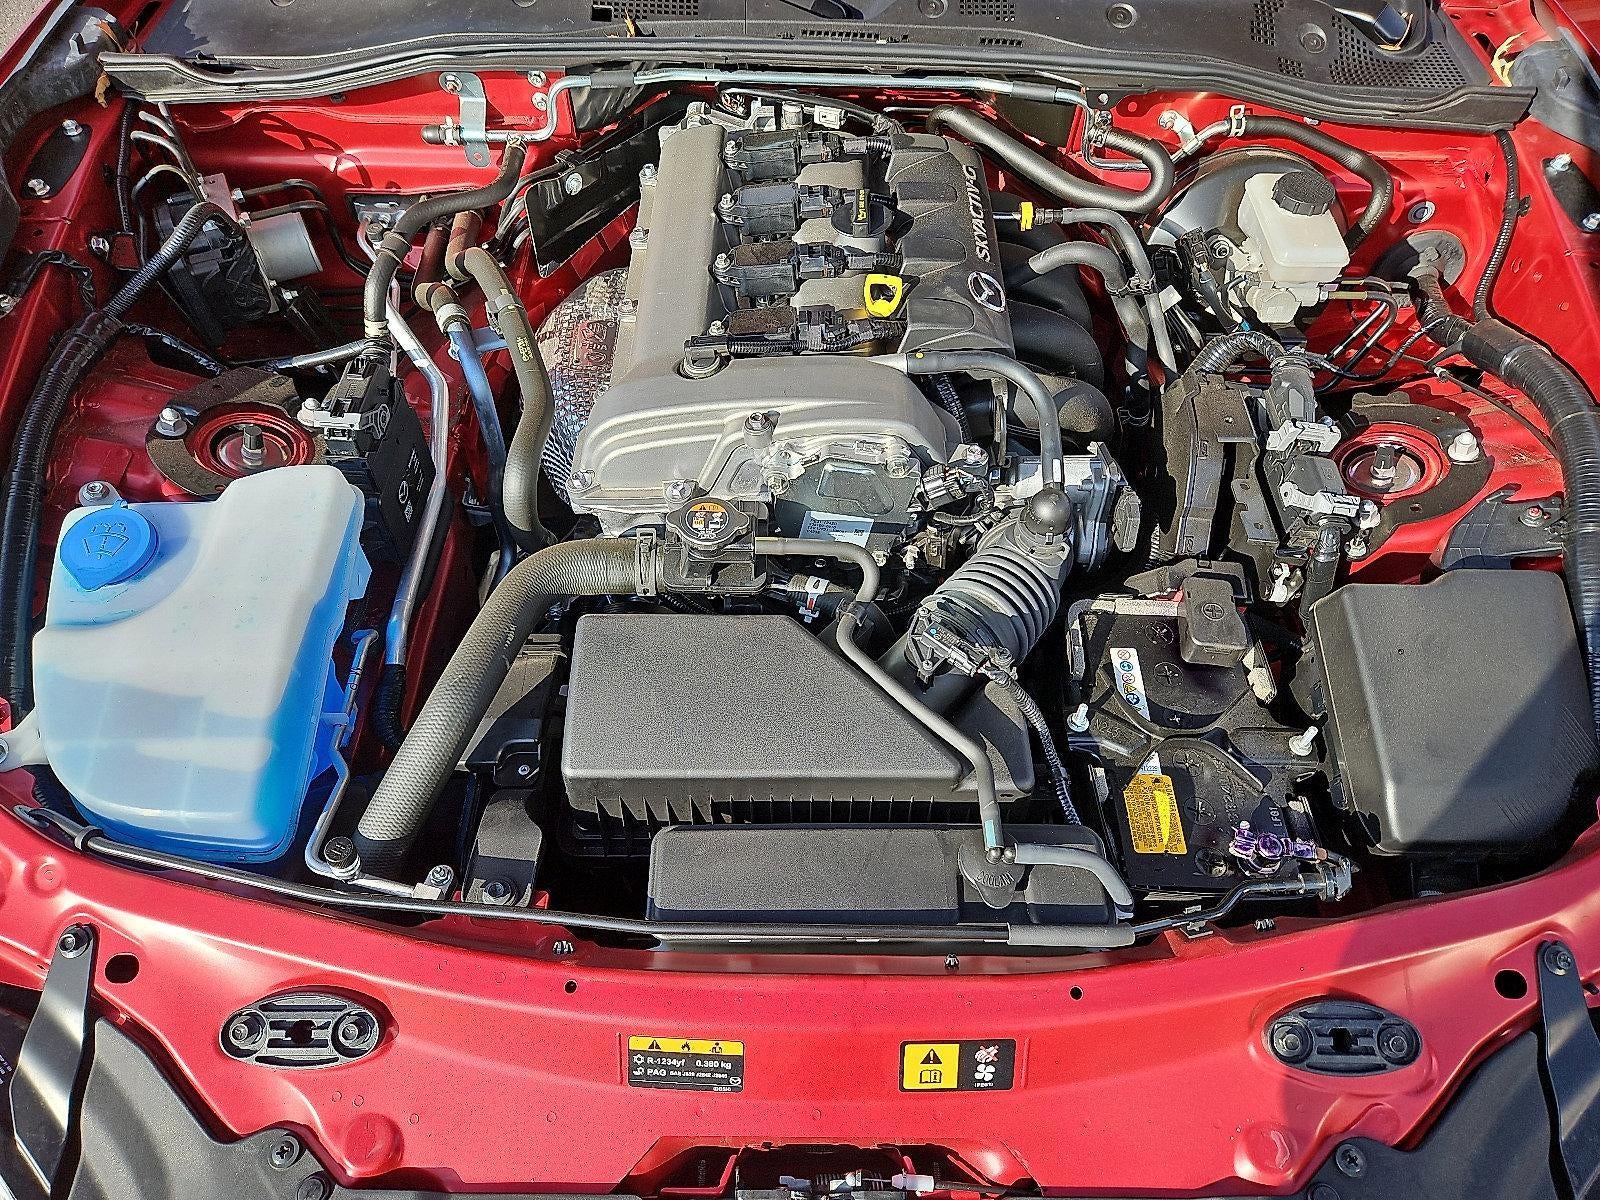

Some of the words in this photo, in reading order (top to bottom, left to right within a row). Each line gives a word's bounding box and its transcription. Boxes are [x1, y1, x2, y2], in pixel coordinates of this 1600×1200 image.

[963, 164, 991, 263] SKYACTIV-G
[647, 1056, 686, 1068] R-1234yf
[720, 1060, 732, 1070] kg
[646, 1068, 667, 1077] PAG
